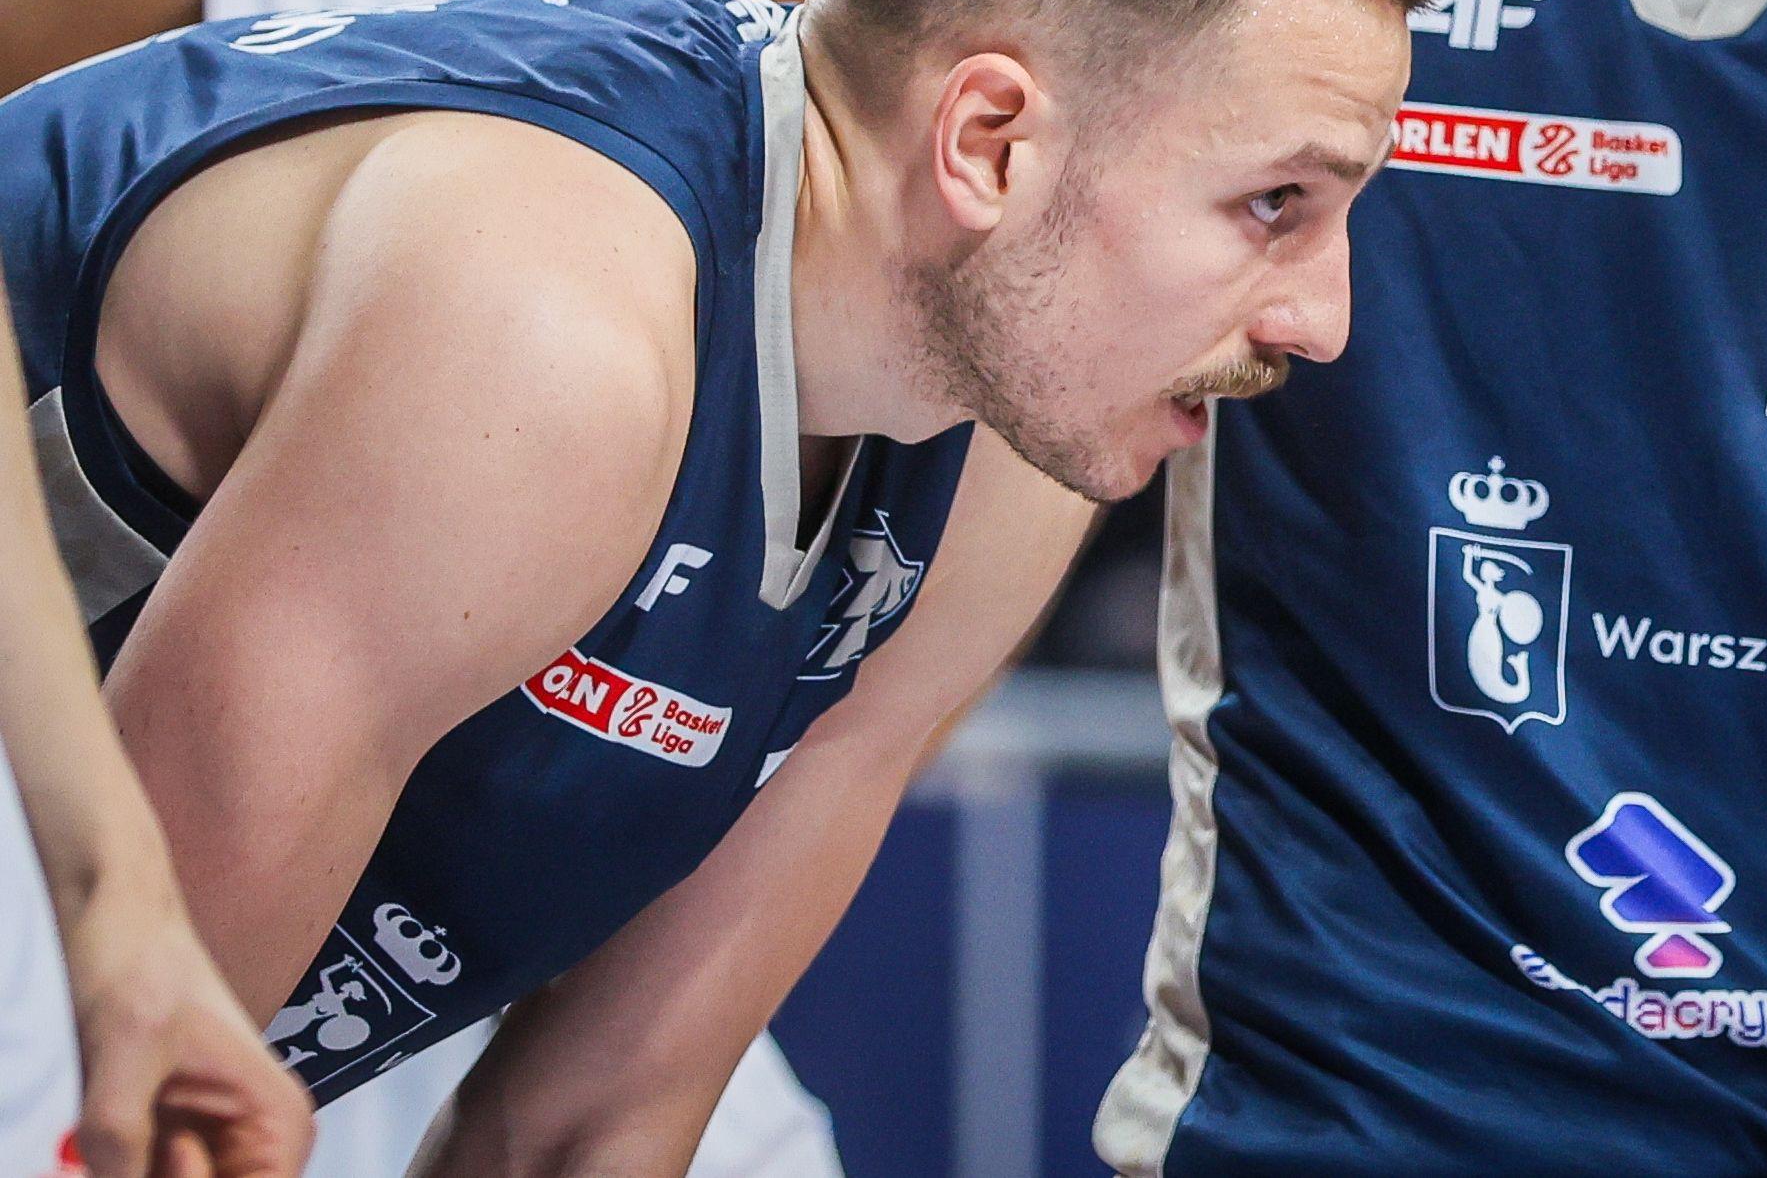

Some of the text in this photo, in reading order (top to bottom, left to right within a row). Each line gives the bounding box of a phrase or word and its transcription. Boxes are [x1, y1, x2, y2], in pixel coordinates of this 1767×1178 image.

[1589, 155, 1638, 182] Liga
[662, 698, 726, 735] Basket
[650, 722, 695, 754] Liga
